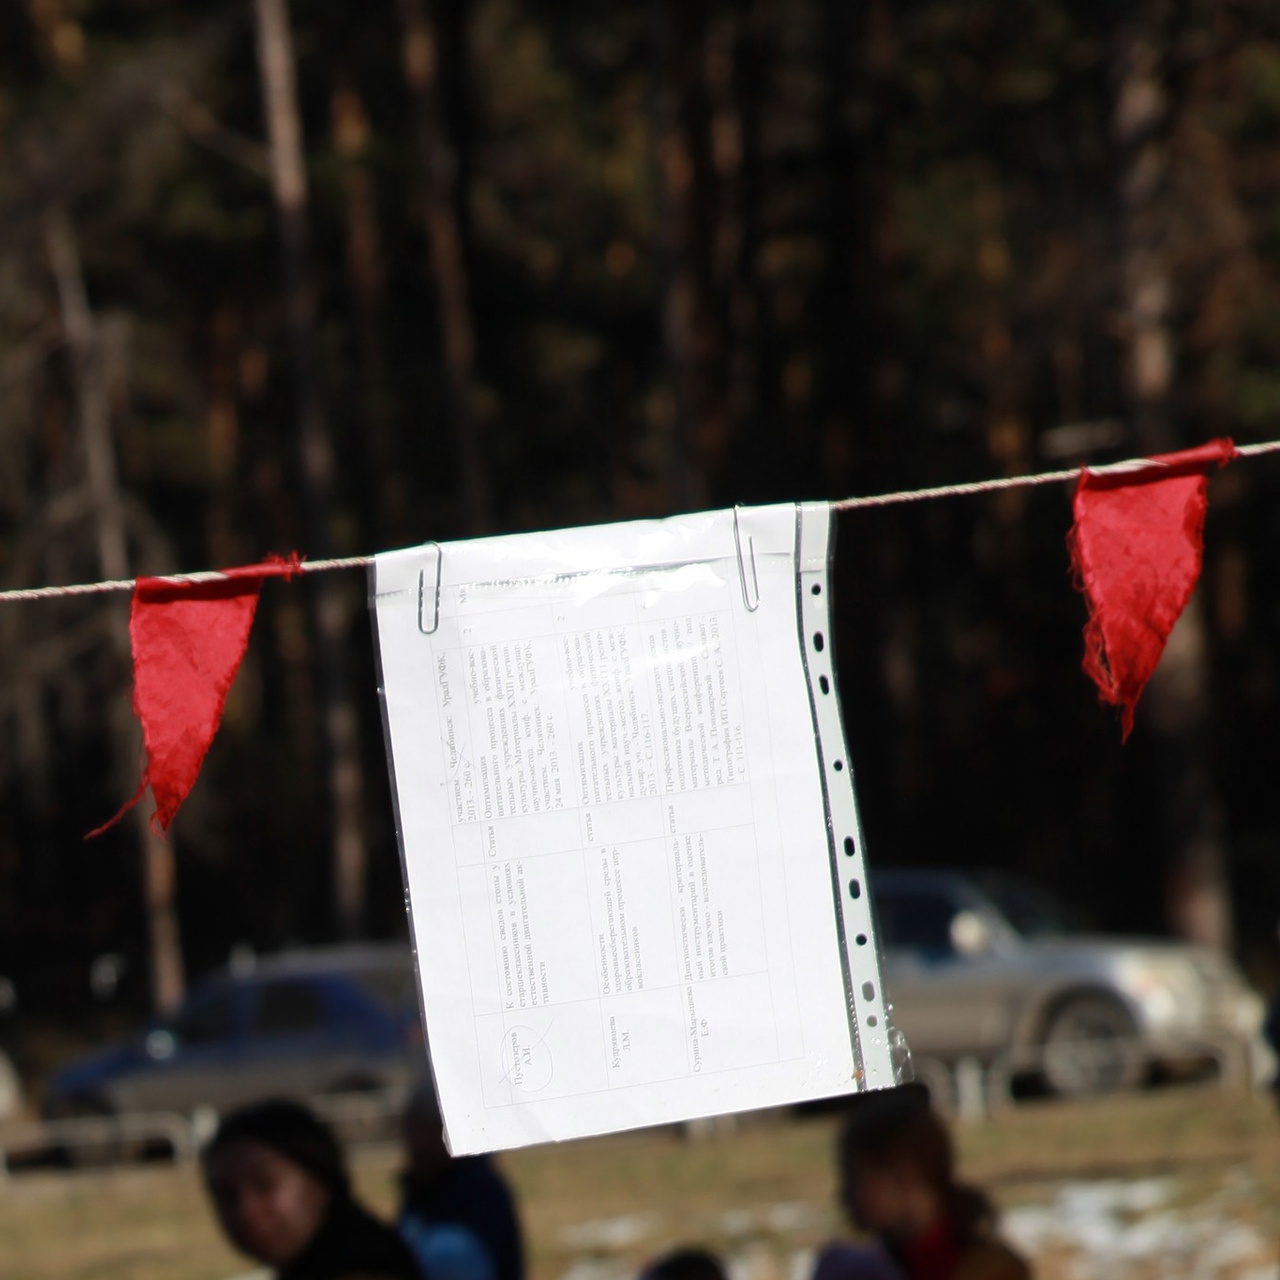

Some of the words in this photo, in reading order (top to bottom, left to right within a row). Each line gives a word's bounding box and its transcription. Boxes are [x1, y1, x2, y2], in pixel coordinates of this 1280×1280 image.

[672, 619, 684, 652] аучно-
[489, 644, 505, 699] физической
[486, 706, 498, 748] процесса
[498, 706, 513, 768] учреждениях
[492, 754, 504, 816] питательного
[506, 775, 516, 815] тельных
[584, 812, 593, 841] статья
[668, 804, 676, 833] статья
[485, 824, 497, 857] Статья
[611, 845, 620, 865] пер-
[685, 835, 694, 867] оценке
[493, 875, 502, 903] стопы
[504, 862, 515, 904] условиях
[601, 857, 610, 886] среды
[614, 868, 625, 909] процессе
[496, 908, 506, 940] сводов
[516, 878, 530, 940] двигательной
[688, 881, 703, 955] инструментарий
[617, 912, 634, 991] образовательном
[715, 909, 727, 952] практики
[500, 945, 512, 996] состоянию
[511, 921, 527, 1007] старшеклассников
[524, 943, 537, 1005] естественной
[597, 933, 610, 994] Особенности
[631, 926, 644, 988] воклассников
[696, 960, 704, 979] ный
[719, 954, 728, 975] ской
[539, 961, 549, 1003] тивности
[506, 1001, 514, 1009] К
[509, 1031, 523, 1085] Пустозеров
[522, 1045, 532, 1065] А.И.
[606, 1015, 621, 1068] Кудрявцева
